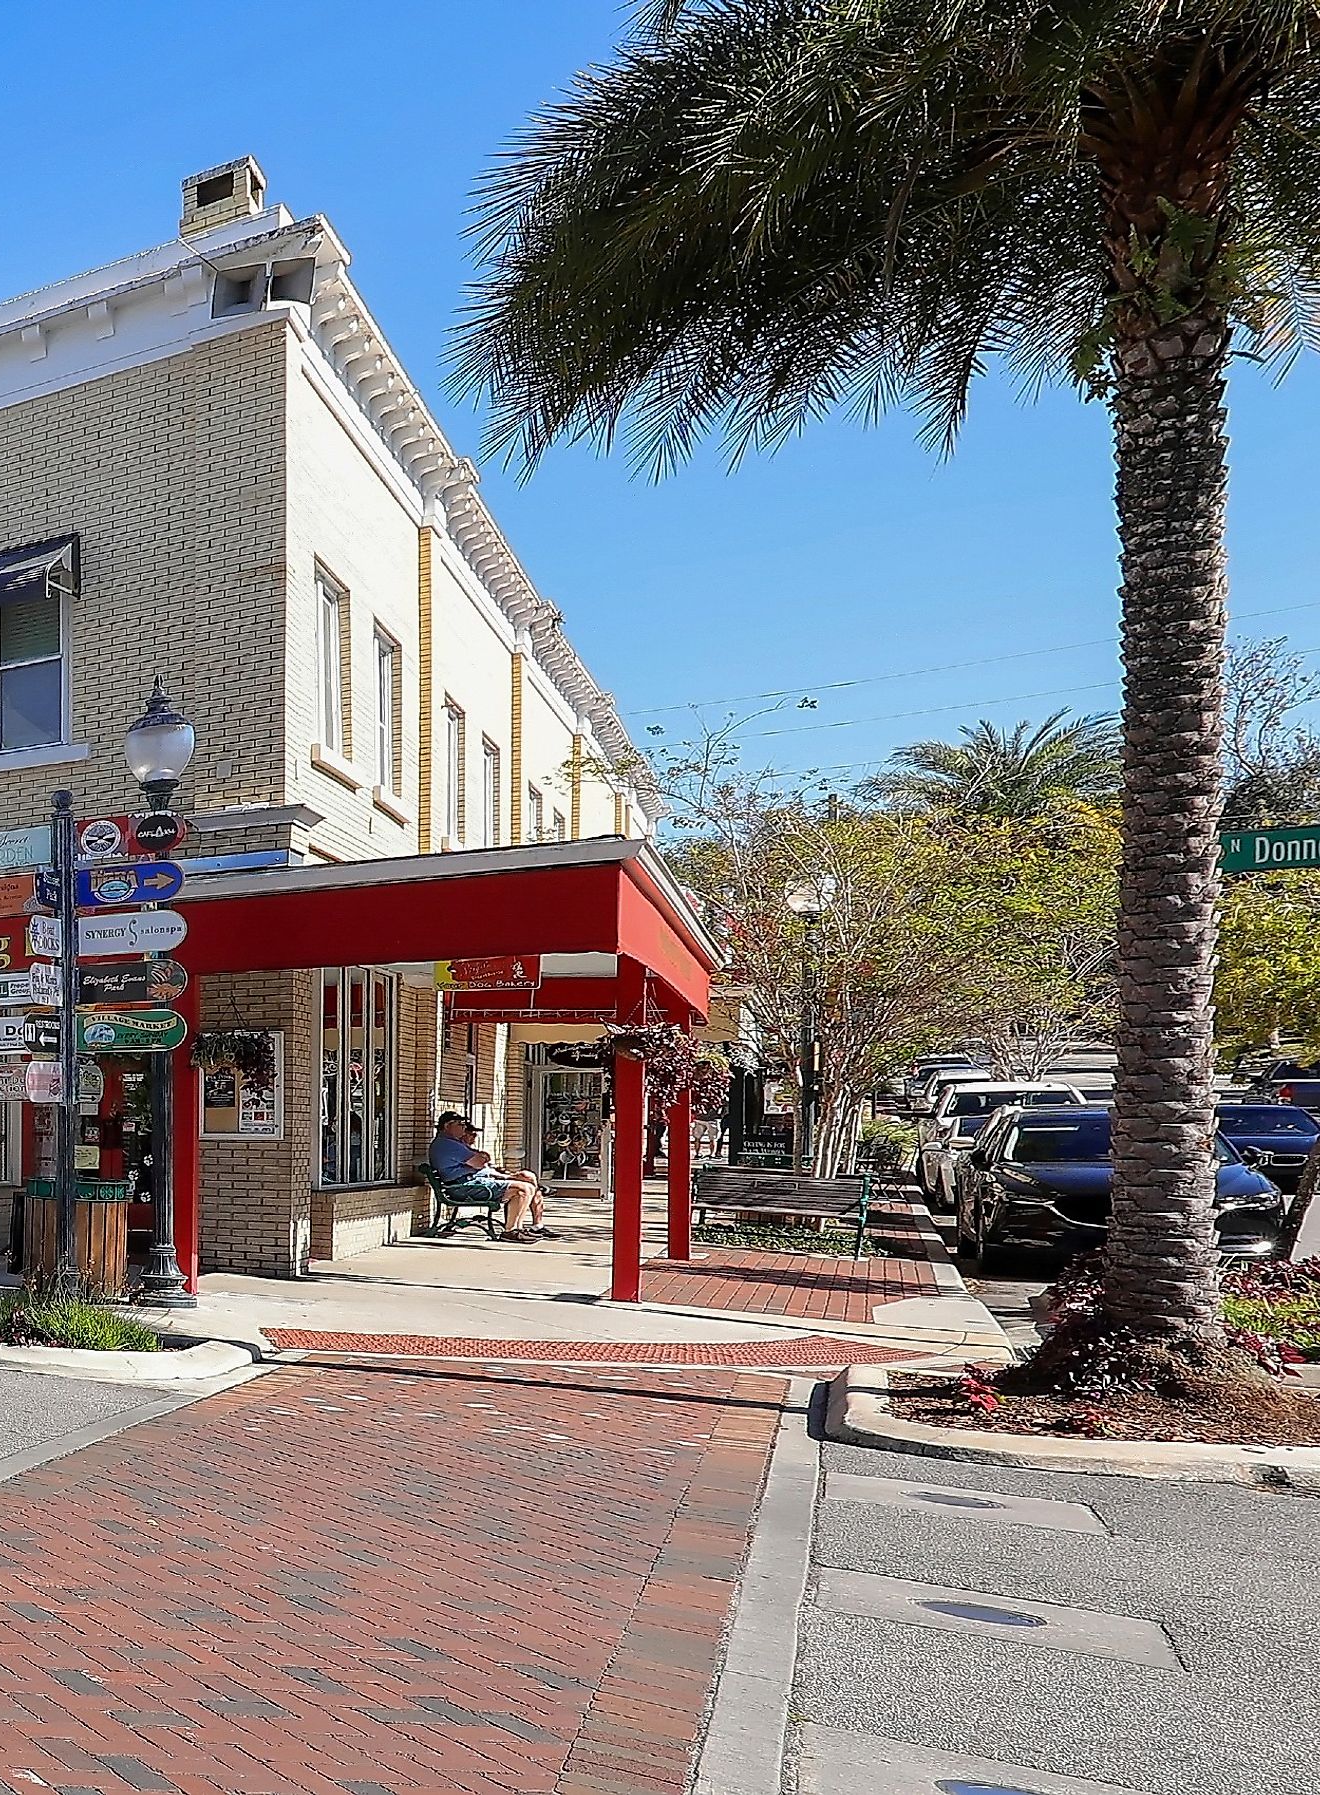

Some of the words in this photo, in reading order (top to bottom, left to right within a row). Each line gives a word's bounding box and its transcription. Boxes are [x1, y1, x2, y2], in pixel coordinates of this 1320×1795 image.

[1231, 838, 1241, 853] N
[1255, 836, 1320, 864] Donn
[85, 928, 126, 940] SYNERGY
[140, 926, 182, 935] salonspa
[83, 974, 119, 987] Elizabeth
[121, 973, 146, 983] Evans
[103, 983, 125, 992] Park
[91, 1014, 129, 1025] VILLAGE
[132, 1020, 173, 1030] MARKET
